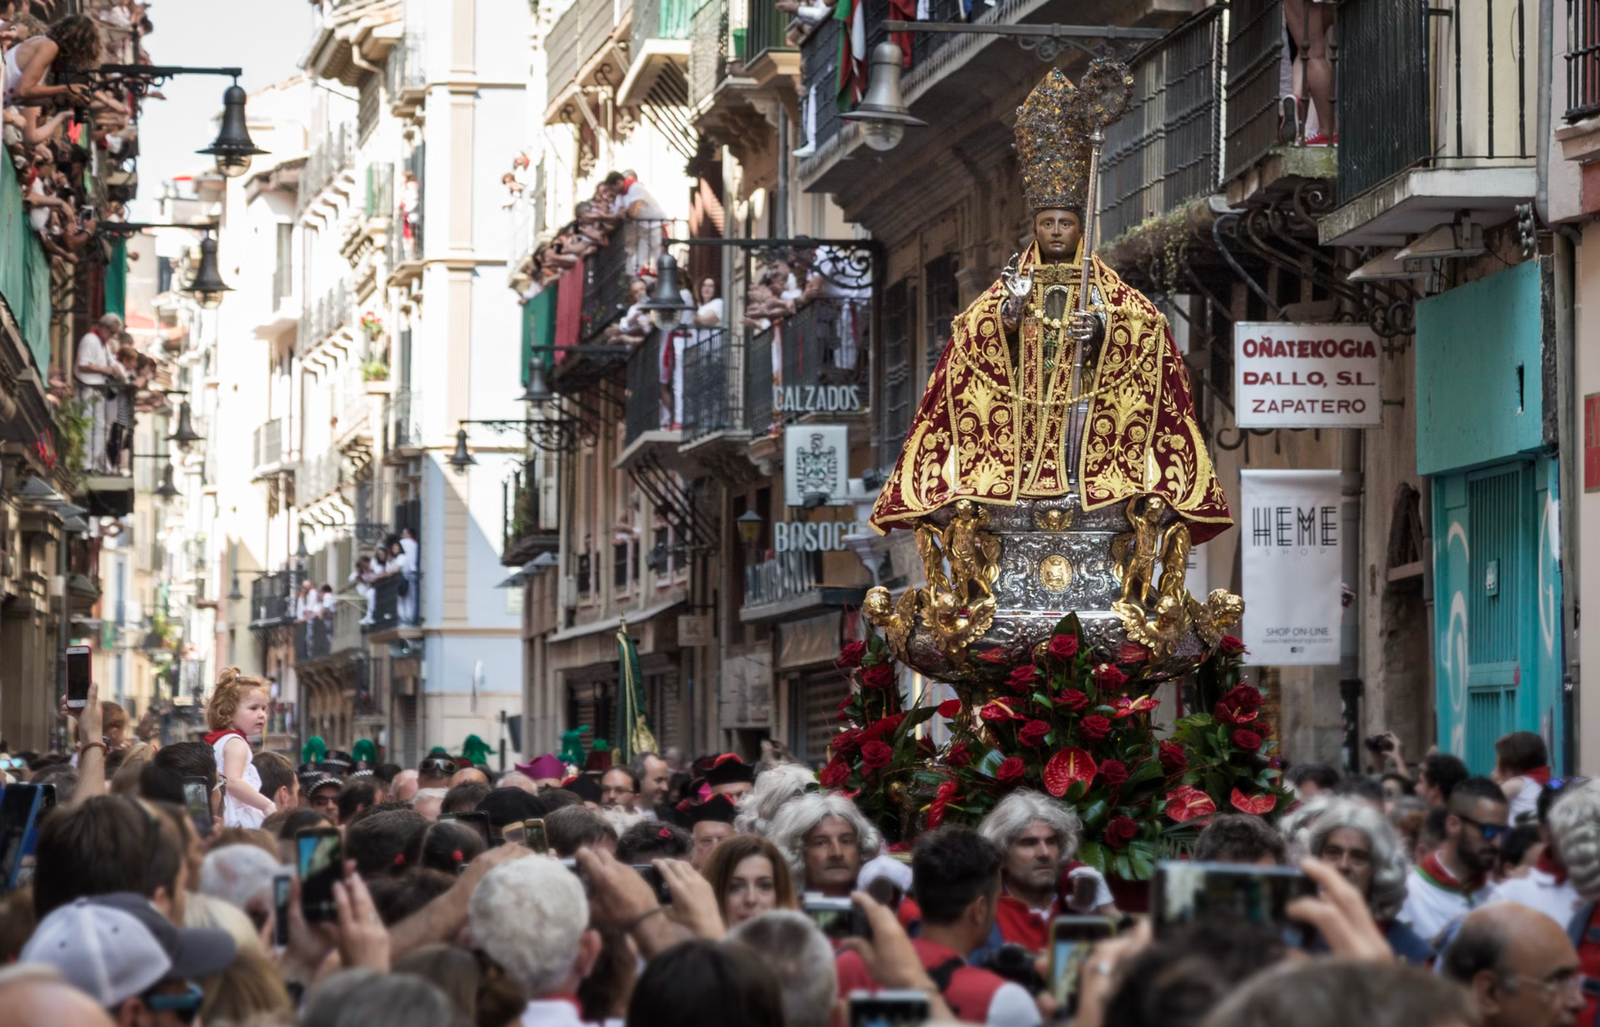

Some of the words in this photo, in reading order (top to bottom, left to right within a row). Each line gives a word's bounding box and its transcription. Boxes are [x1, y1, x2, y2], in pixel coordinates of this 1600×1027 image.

[1242, 336, 1377, 358] OÑATEKOGIA
[1243, 371, 1328, 388] DALLO,
[773, 385, 860, 411] CALZADOS
[1252, 399, 1366, 413] ZAPATERO
[1253, 507, 1337, 547] HEME
[1265, 548, 1326, 556] SHOP
[1266, 627, 1290, 637] SHOP
[1292, 627, 1330, 637] ON-LINE
